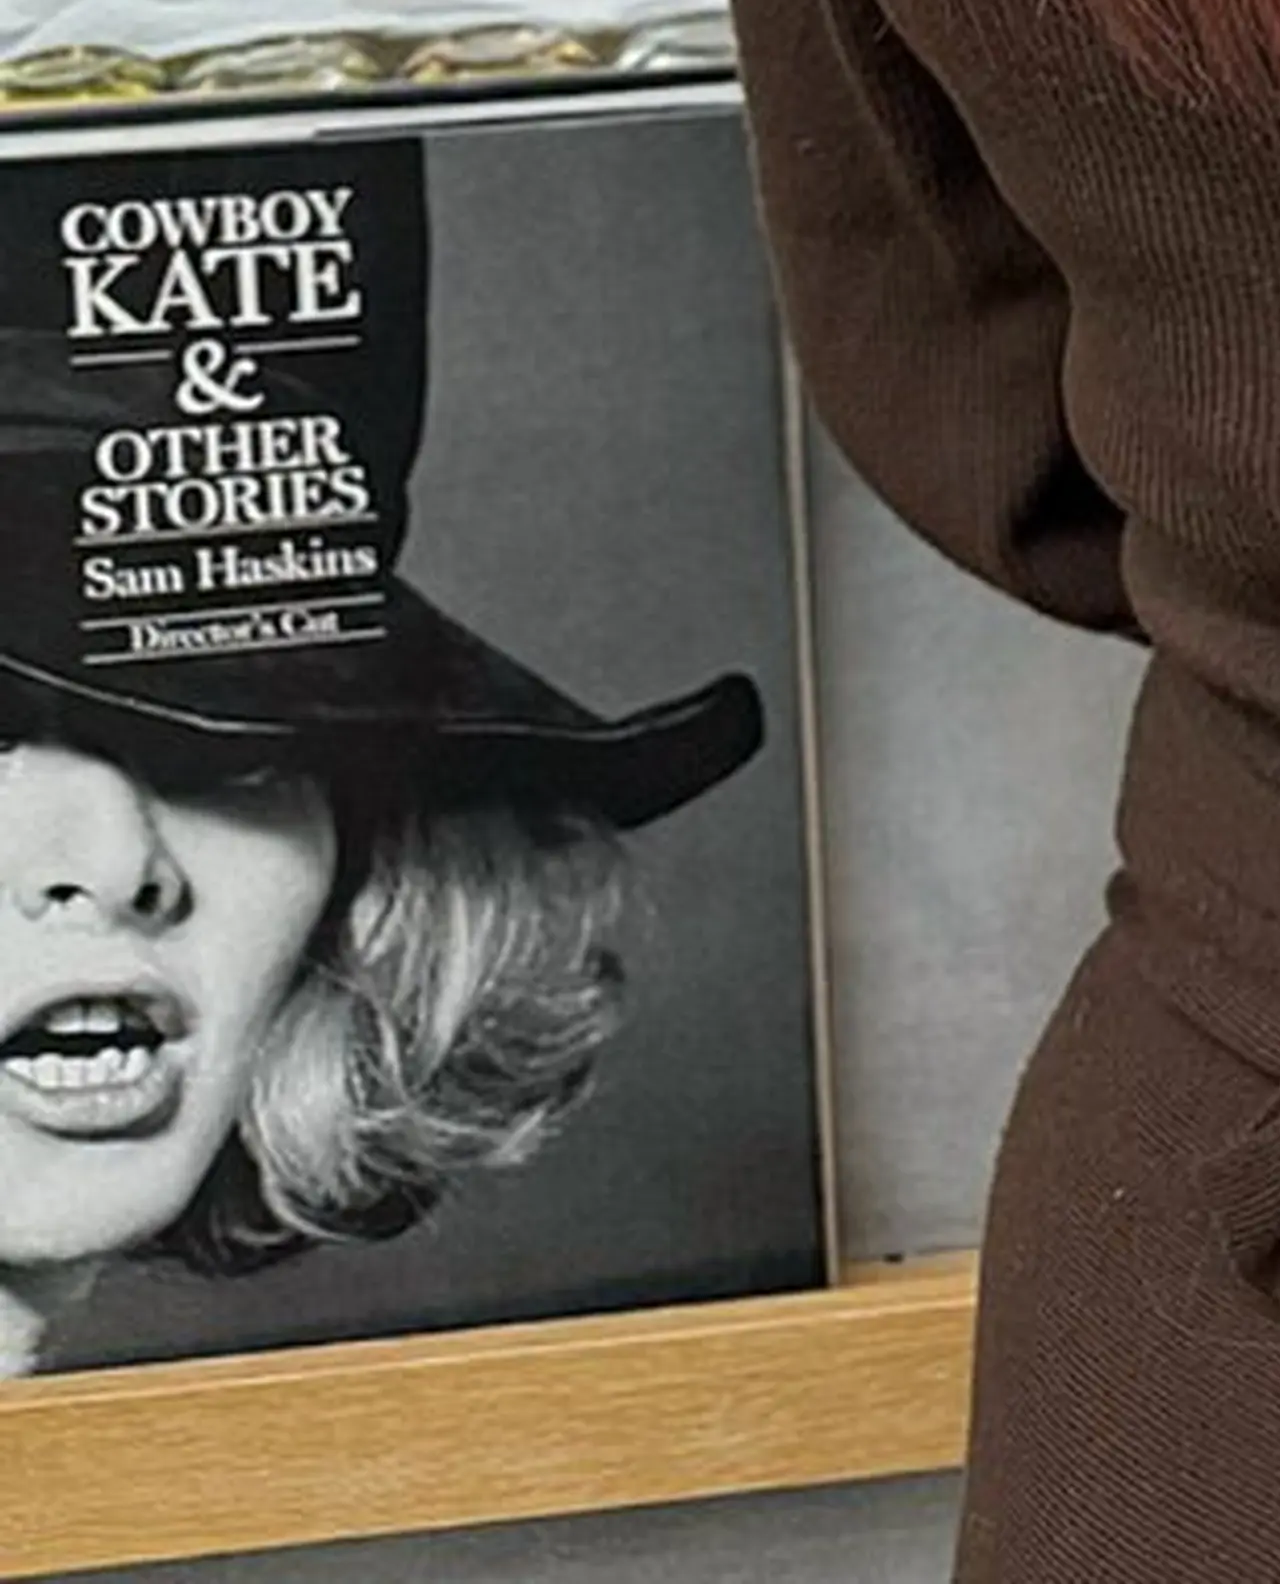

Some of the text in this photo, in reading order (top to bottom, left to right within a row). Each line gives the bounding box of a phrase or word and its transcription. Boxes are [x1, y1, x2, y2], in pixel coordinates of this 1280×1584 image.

[61, 187, 353, 253] COWBOY
[62, 240, 361, 338] KATE
[175, 338, 265, 414] &
[96, 415, 351, 482] OTHER
[81, 466, 370, 537] STORIES
[83, 536, 378, 600] Sam Haskins
